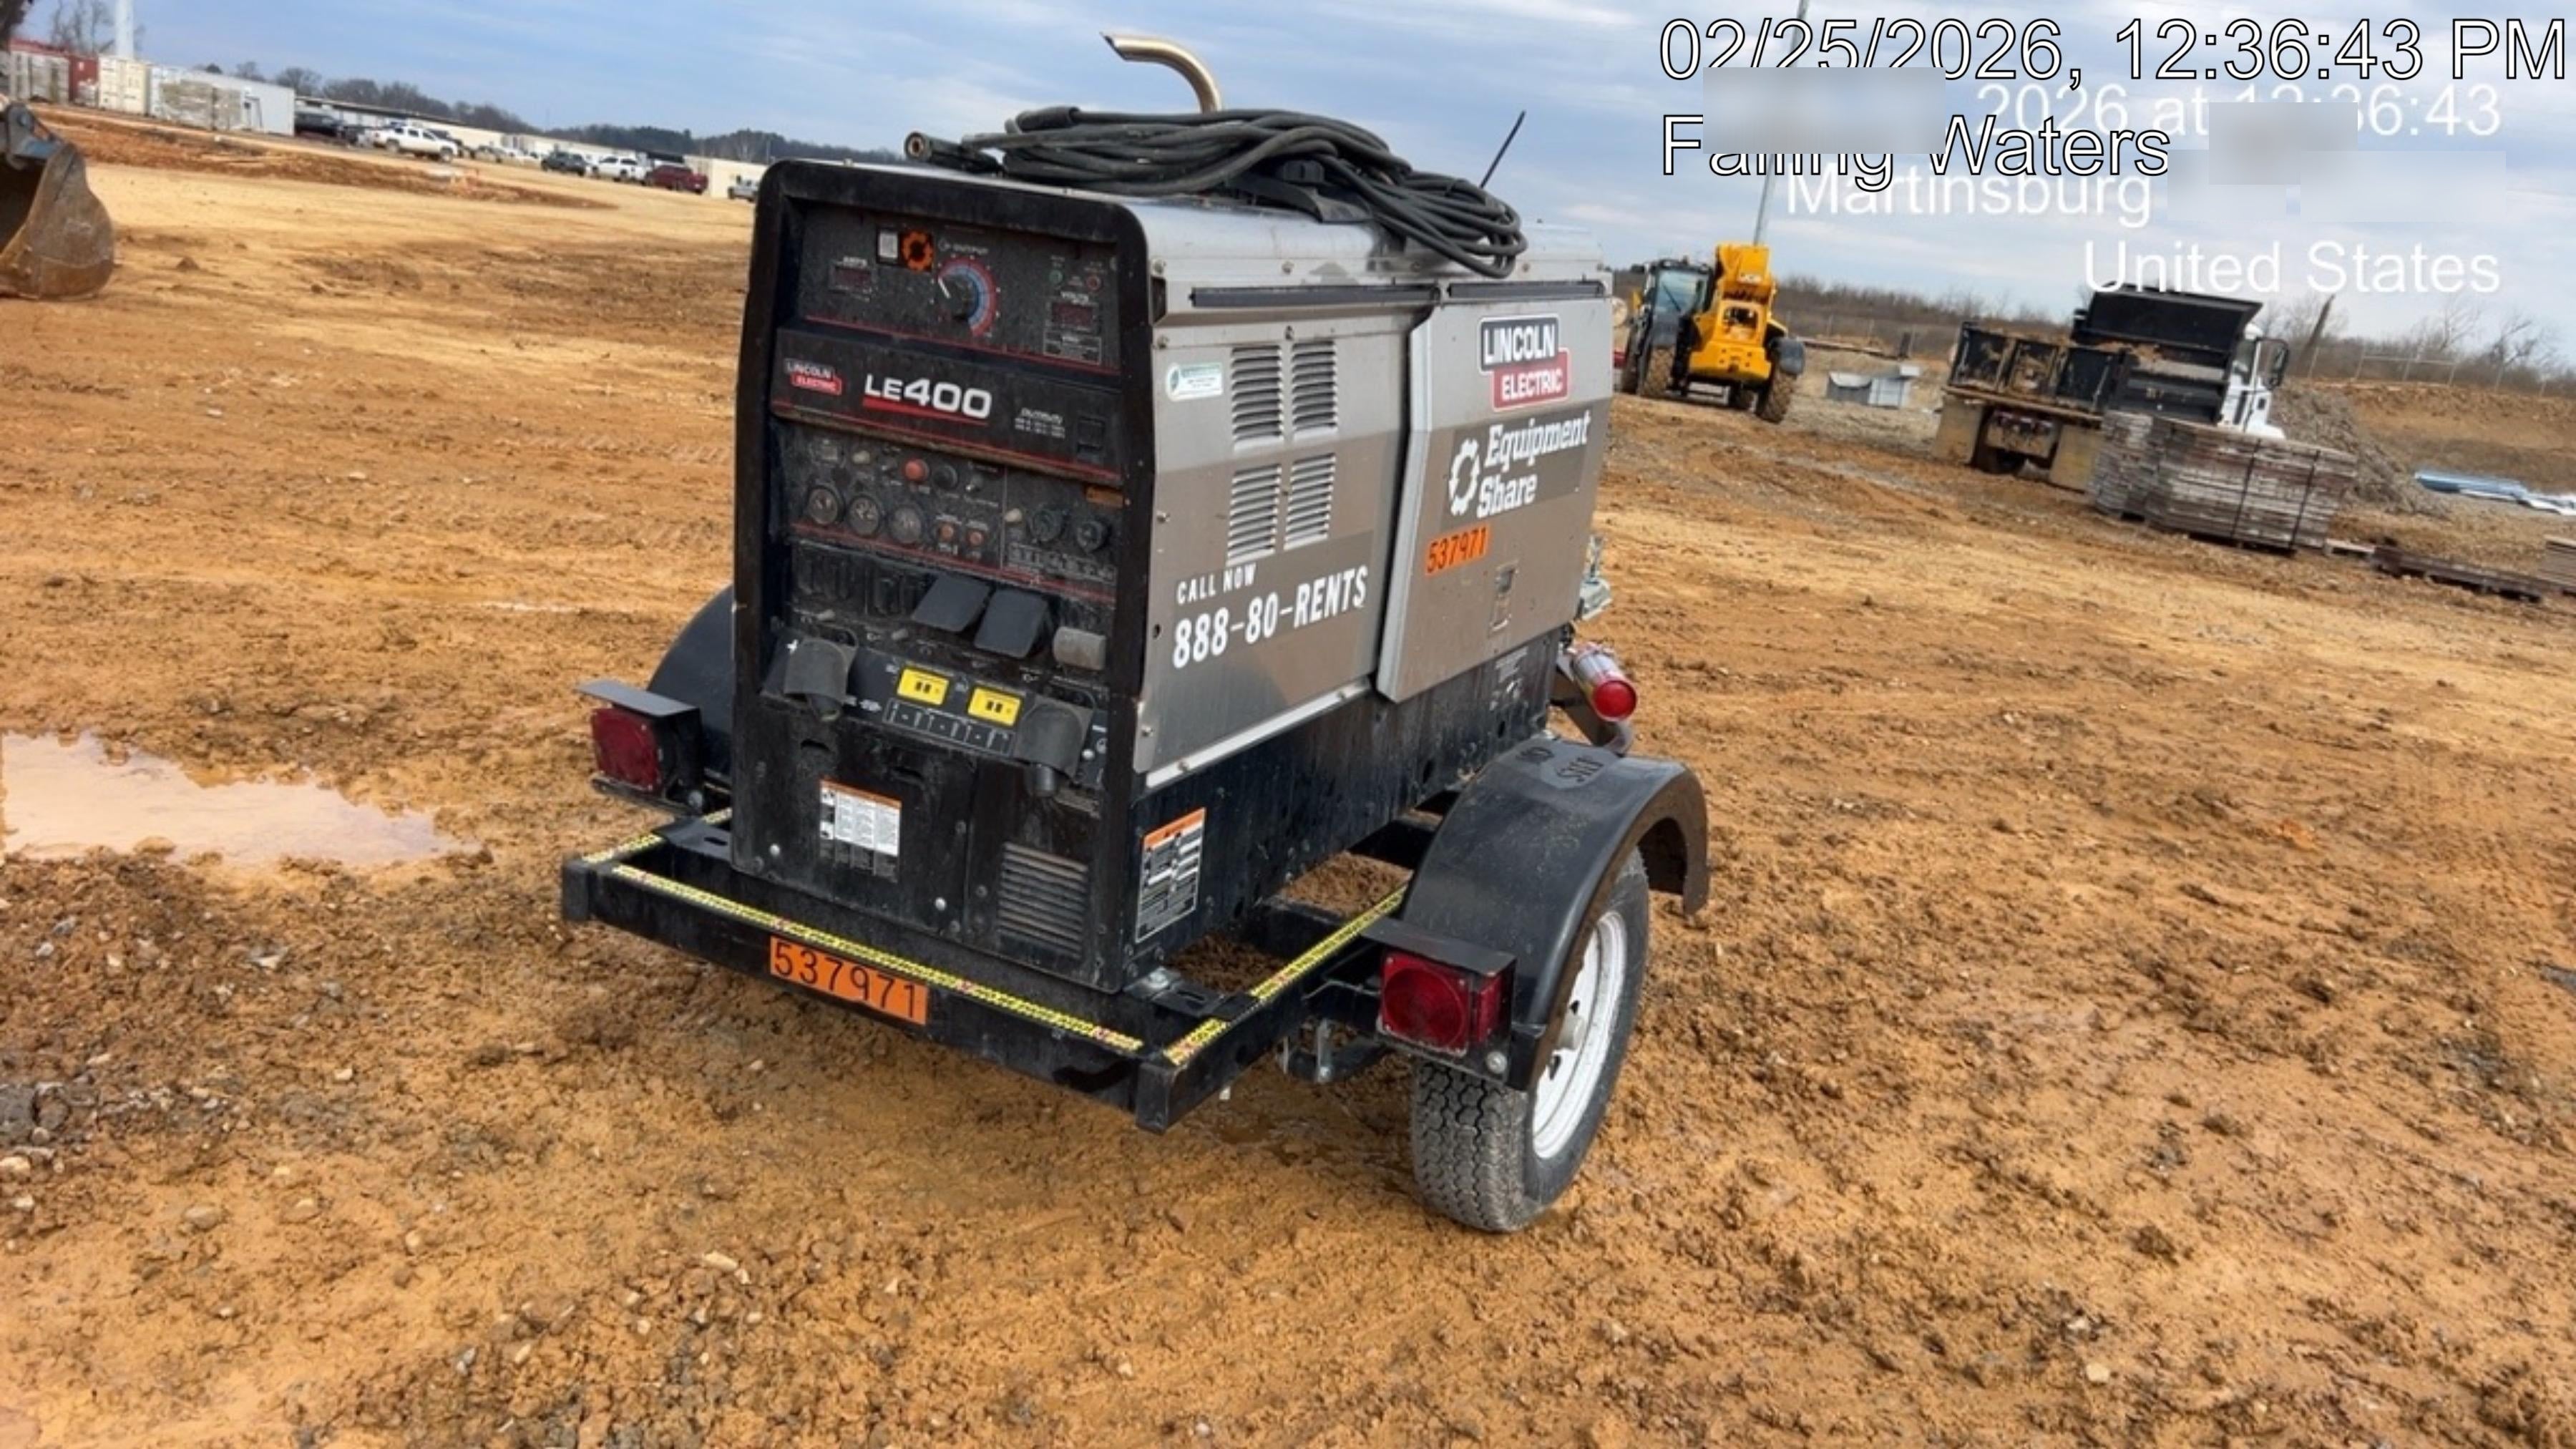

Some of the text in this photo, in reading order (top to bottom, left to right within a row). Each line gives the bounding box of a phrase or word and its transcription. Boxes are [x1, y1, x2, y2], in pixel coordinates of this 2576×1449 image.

[1484, 323, 1556, 365] LINCOLN
[786, 361, 833, 379] LINCOLN
[796, 376, 837, 392] ELECTRIC
[1501, 369, 1563, 401] ELECTRIC
[864, 374, 992, 419] LE400
[1485, 409, 1592, 473] Equipment
[1476, 474, 1538, 519] Share
[1426, 525, 1486, 573] 537971
[1177, 562, 1257, 606] CALL NOW
[1172, 564, 1368, 669] 888-80-RENTS
[774, 942, 916, 1018] 537971
